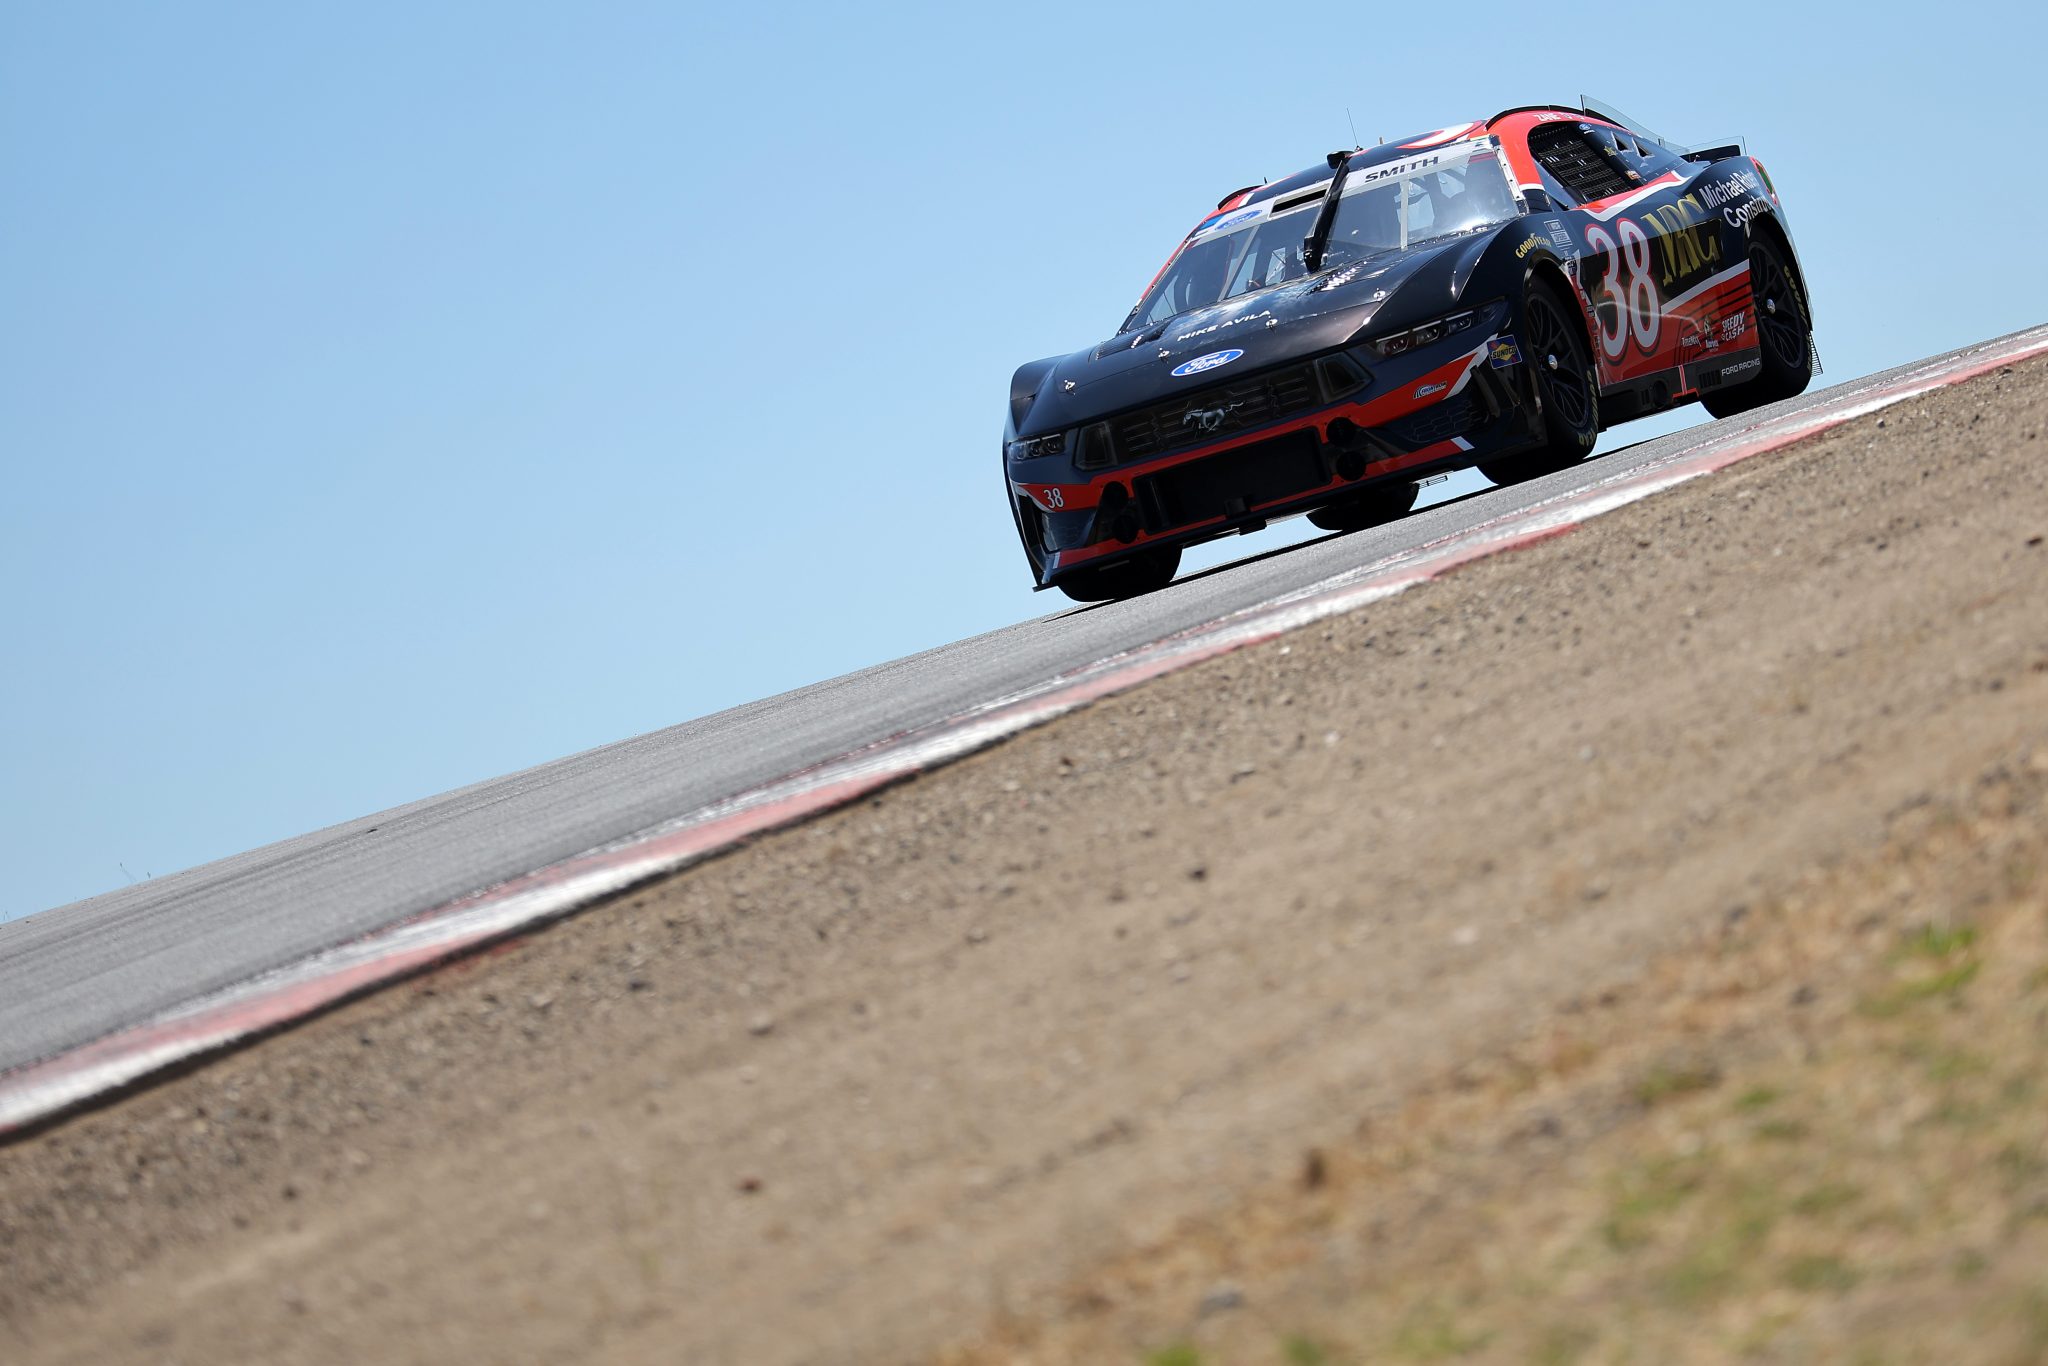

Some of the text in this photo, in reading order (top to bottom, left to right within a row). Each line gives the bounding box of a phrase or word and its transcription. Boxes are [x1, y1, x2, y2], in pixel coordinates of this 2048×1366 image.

[1364, 156, 1439, 182] SMITH
[1699, 173, 1746, 209] Michael
[1585, 218, 1661, 360] 38
[1177, 310, 1271, 341] MIKE AVILA
[1721, 311, 1745, 332] SPEEDY
[1726, 324, 1745, 342] CASH
[1183, 352, 1230, 373] Ford
[1491, 345, 1517, 359] SUNOCO
[1721, 358, 1761, 377] FORD RACING
[1043, 488, 1064, 509] 38
